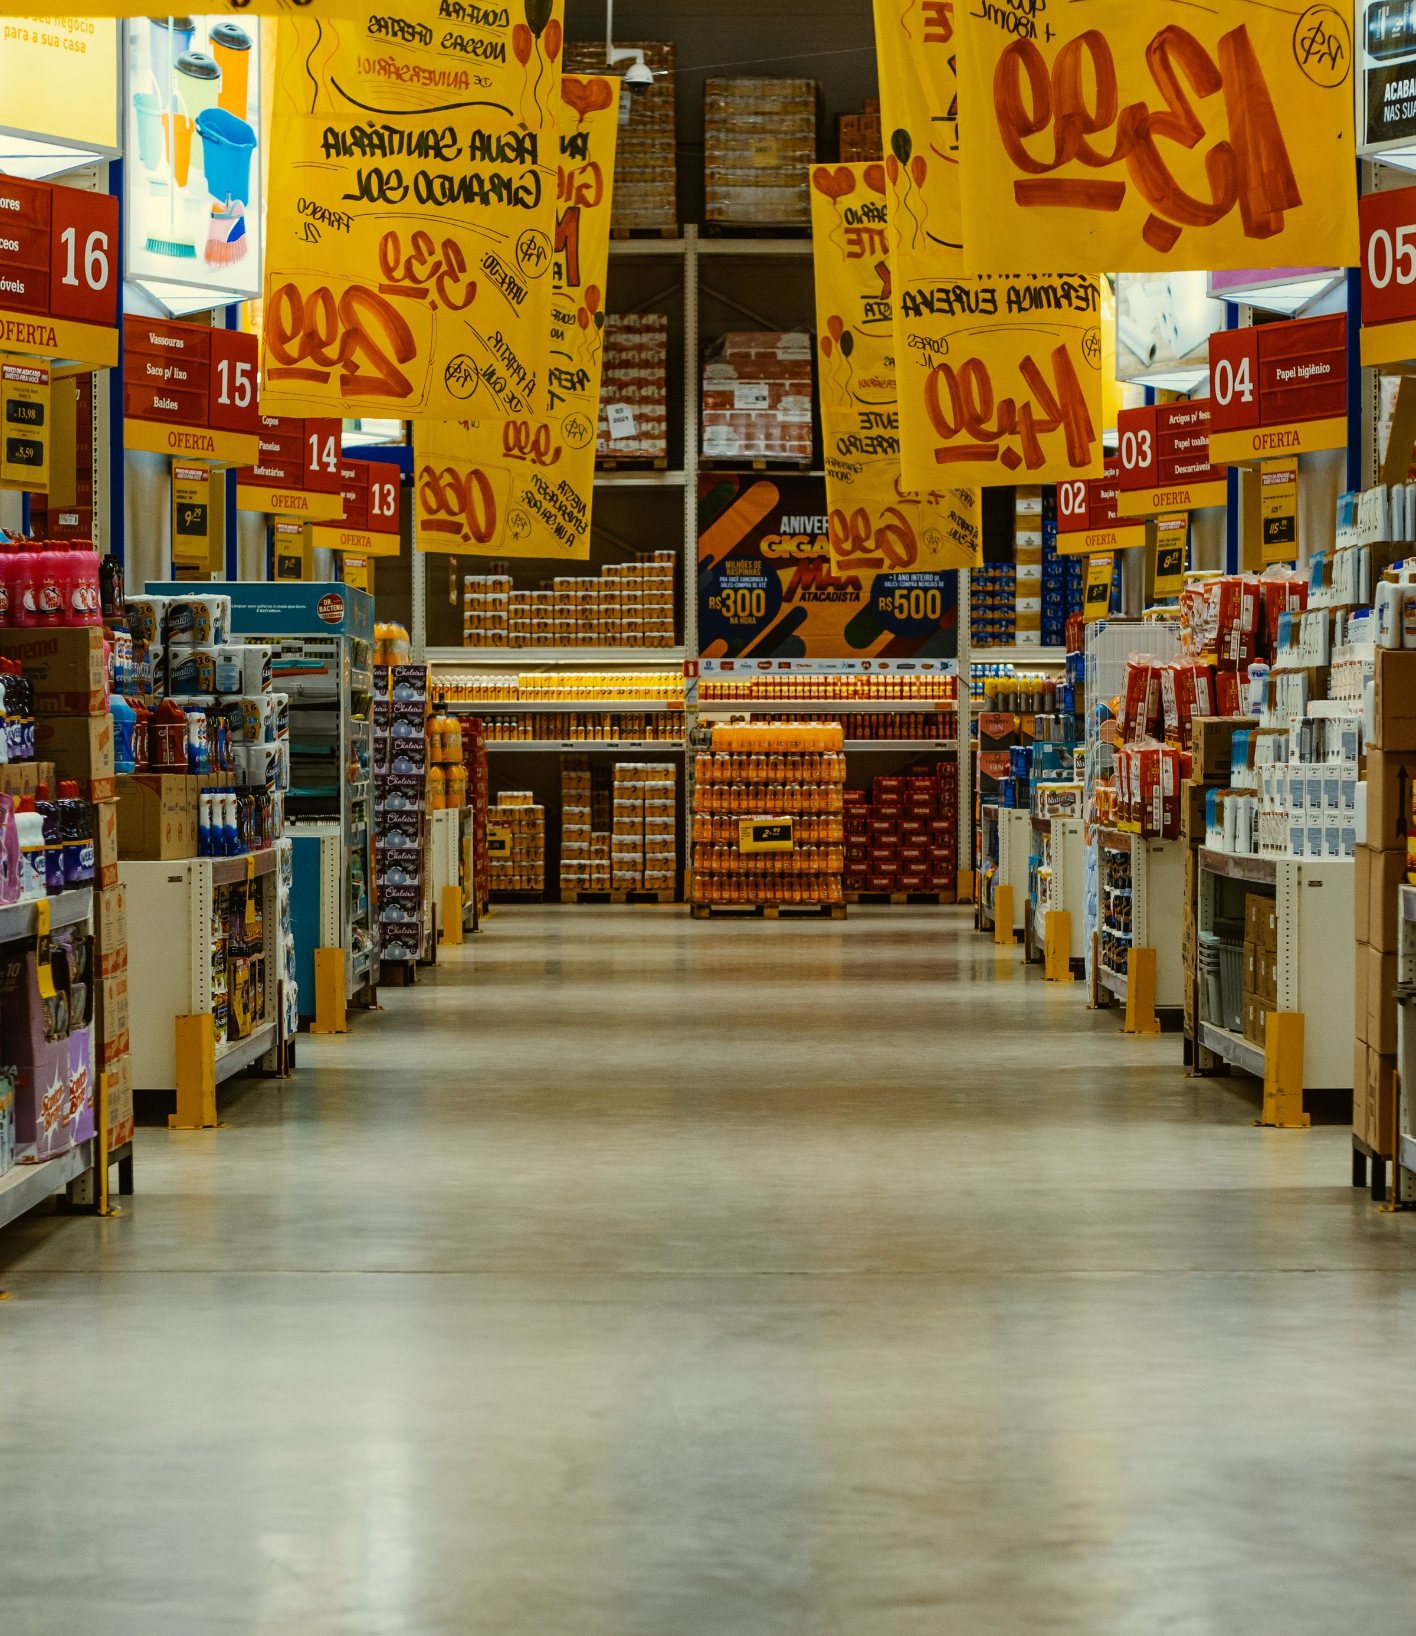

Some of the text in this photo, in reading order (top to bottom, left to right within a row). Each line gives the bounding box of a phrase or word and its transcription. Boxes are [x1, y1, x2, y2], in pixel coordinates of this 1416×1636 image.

[4, 23, 86, 53] para a sua casa
[1383, 103, 1401, 122] NAS
[61, 227, 108, 291] 16
[149, 332, 184, 349] Vassouras
[146, 363, 187, 380] Saco p/ lixo
[1277, 363, 1331, 380] Papel higiênico
[217, 359, 252, 408] 15
[1215, 357, 1253, 406] 04
[153, 397, 179, 411] Baldes
[261, 416, 279, 427] Copos
[1169, 414, 1190, 425] Artigos
[167, 431, 215, 452] OFERTA
[258, 440, 280, 452] Panelas
[1174, 438, 1190, 451] Papel
[1252, 430, 1301, 451] OFERTA
[309, 434, 337, 473] 14
[1121, 430, 1152, 470] 03
[253, 465, 285, 478] Refratários
[1175, 462, 1211, 475] Descartáveis
[271, 494, 308, 510] OFERTA
[371, 483, 395, 516] 13
[1060, 481, 1086, 516] 02
[1153, 490, 1191, 507] OFERTA
[340, 533, 371, 548] OFERTA
[1085, 533, 1117, 547] OFERTA
[725, 559, 752, 568] MILHÕES
[721, 588, 766, 617] 300
[800, 591, 861, 603] ATACADISTA
[894, 588, 941, 619] 500
